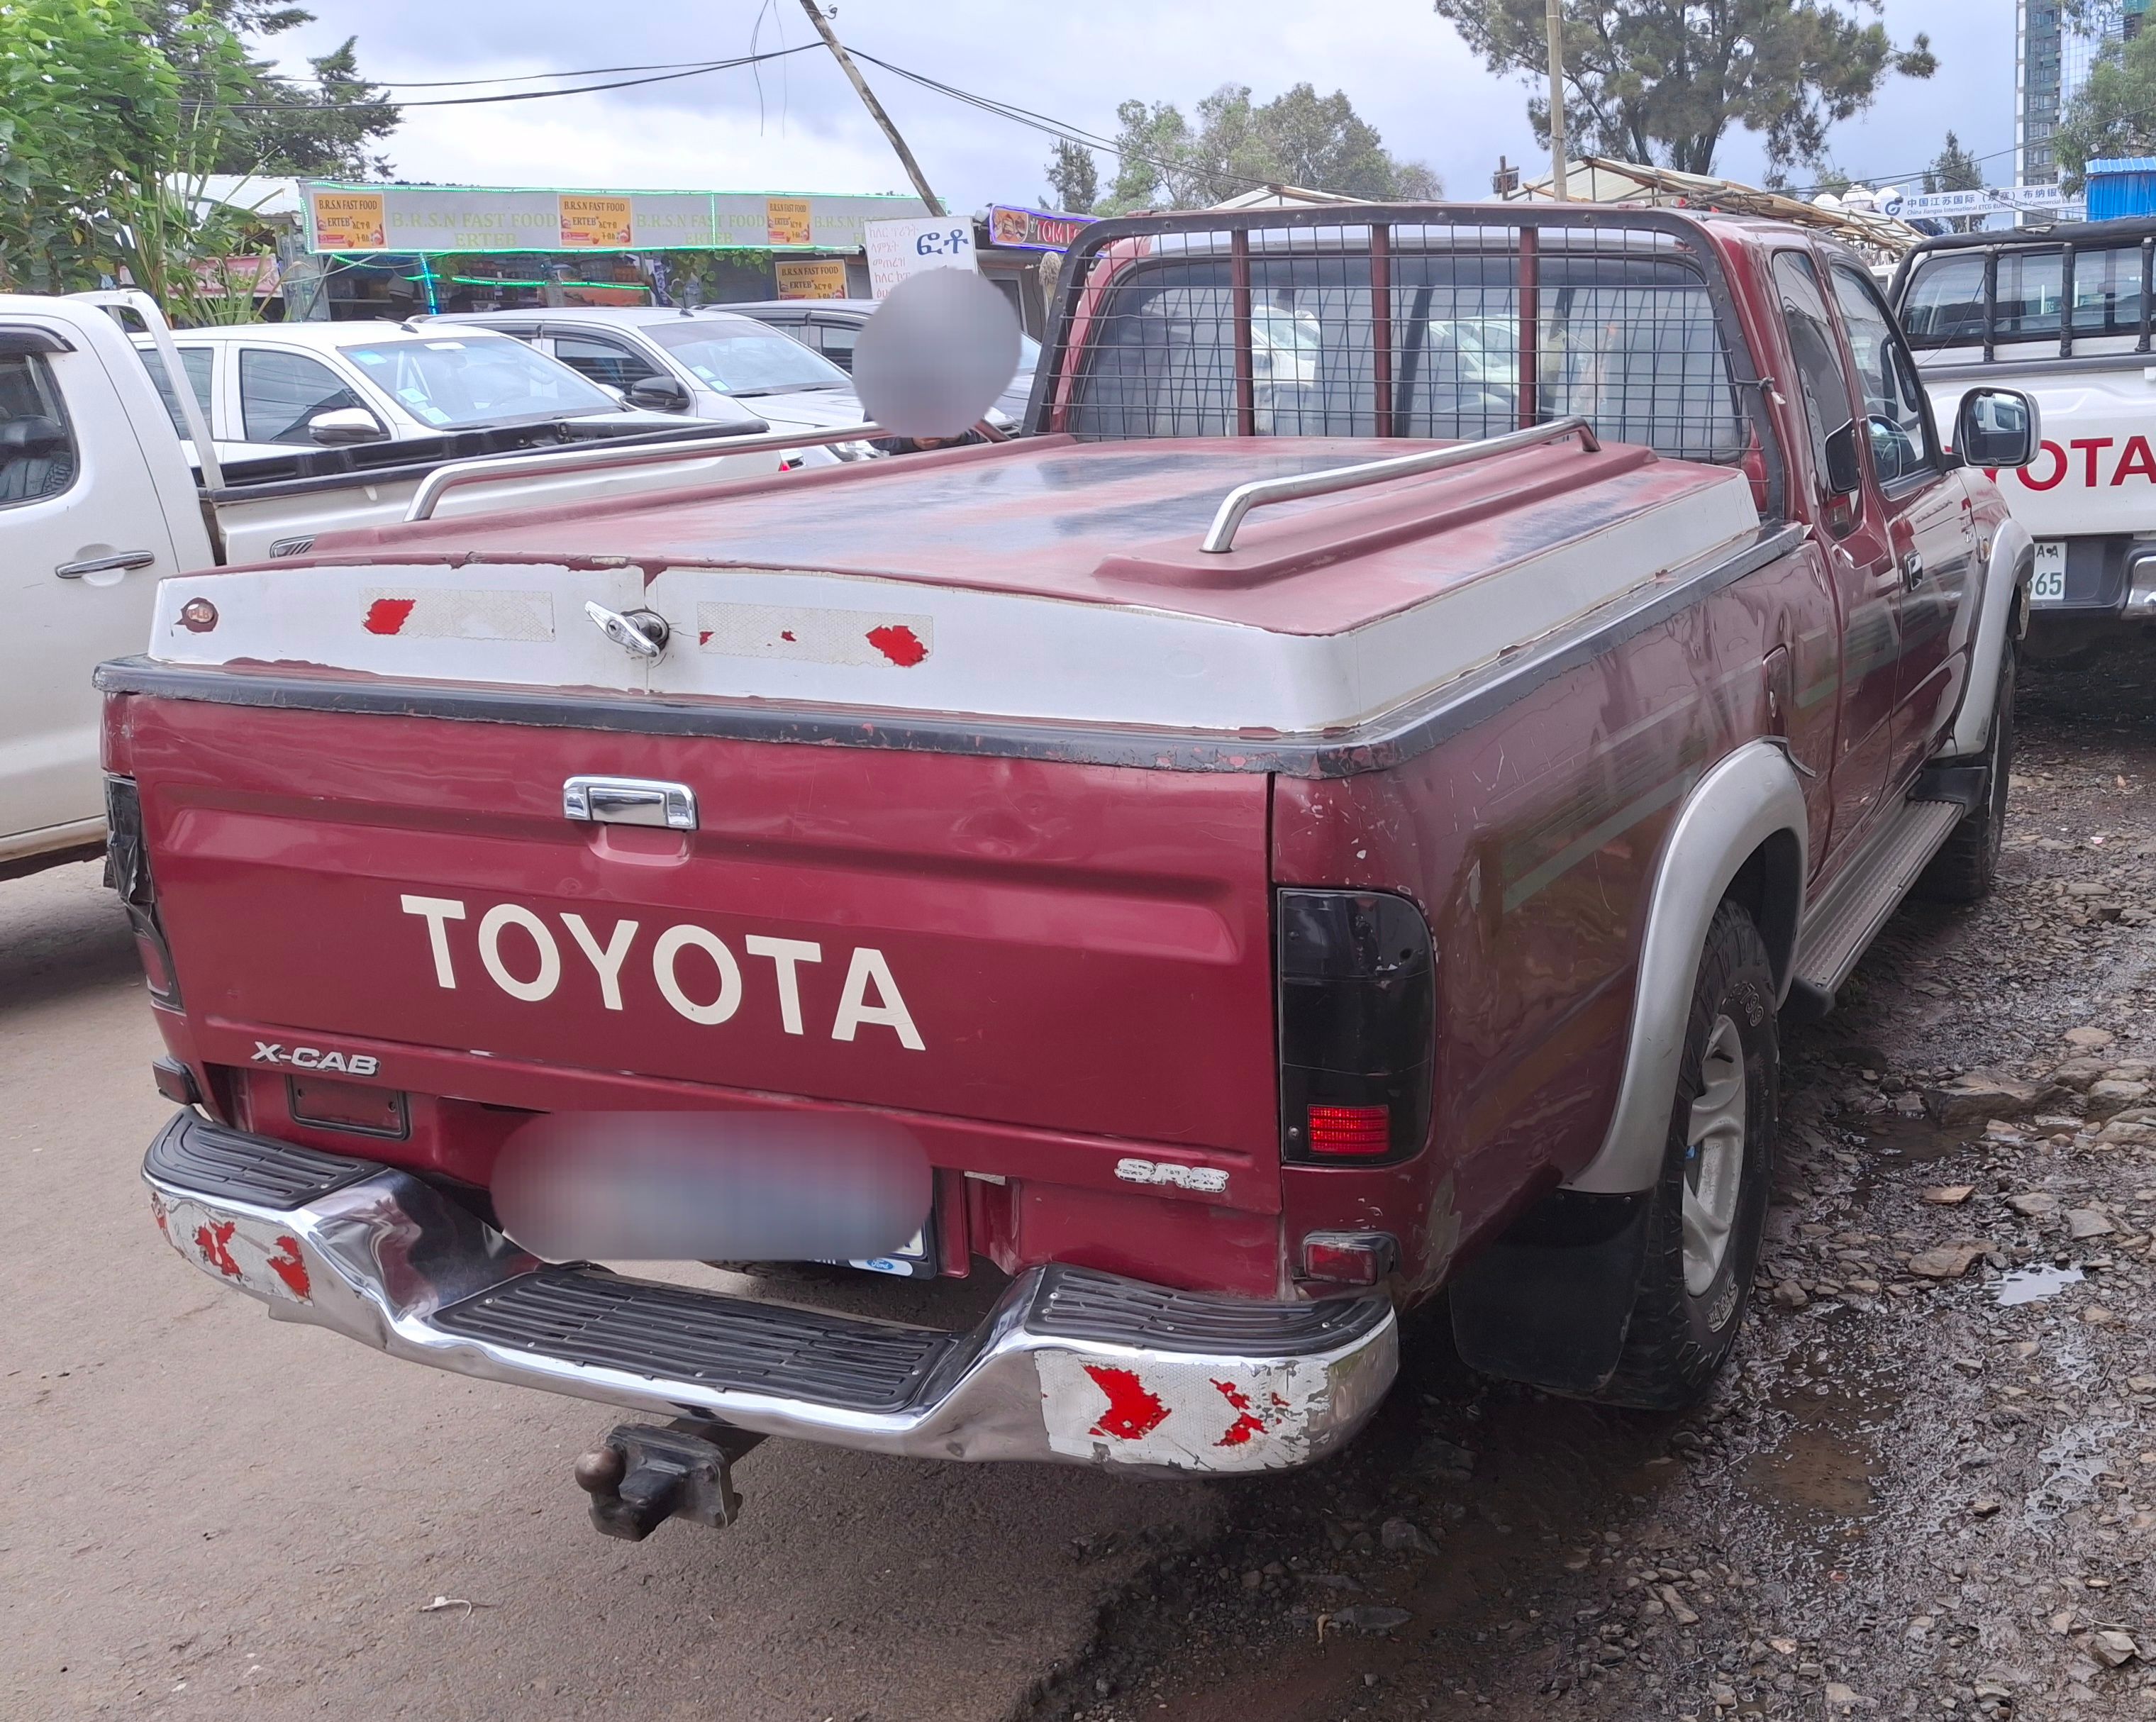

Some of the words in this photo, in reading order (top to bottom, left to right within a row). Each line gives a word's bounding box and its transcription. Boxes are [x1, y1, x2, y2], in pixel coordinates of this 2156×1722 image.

[319, 200, 341, 210] B.R.S.N
[343, 200, 358, 210] FAST
[360, 201, 377, 210] FOOD
[564, 201, 587, 210] B.R.S.N
[589, 202, 605, 211] FAST
[606, 203, 625, 211] FOOD
[327, 217, 350, 227] ERTEB
[391, 213, 455, 228] B.R.S.N
[462, 213, 505, 228] FAST
[511, 213, 557, 228] FOOD
[572, 217, 596, 226] ERTEB
[637, 215, 686, 228] B.R.S.N
[728, 215, 765, 228] FOOD
[815, 216, 854, 228] B.R.S.N
[1036, 220, 1062, 243] TOM
[455, 233, 516, 247] ERTEB
[916, 228, 969, 255] ፎቶ
[804, 267, 820, 275] FAST
[821, 266, 838, 274] FOOD
[1984, 435, 2156, 491] OTA
[2030, 572, 2062, 595] 65
[400, 894, 926, 1051] TOYOTA
[250, 1041, 379, 1076] X-CAB
